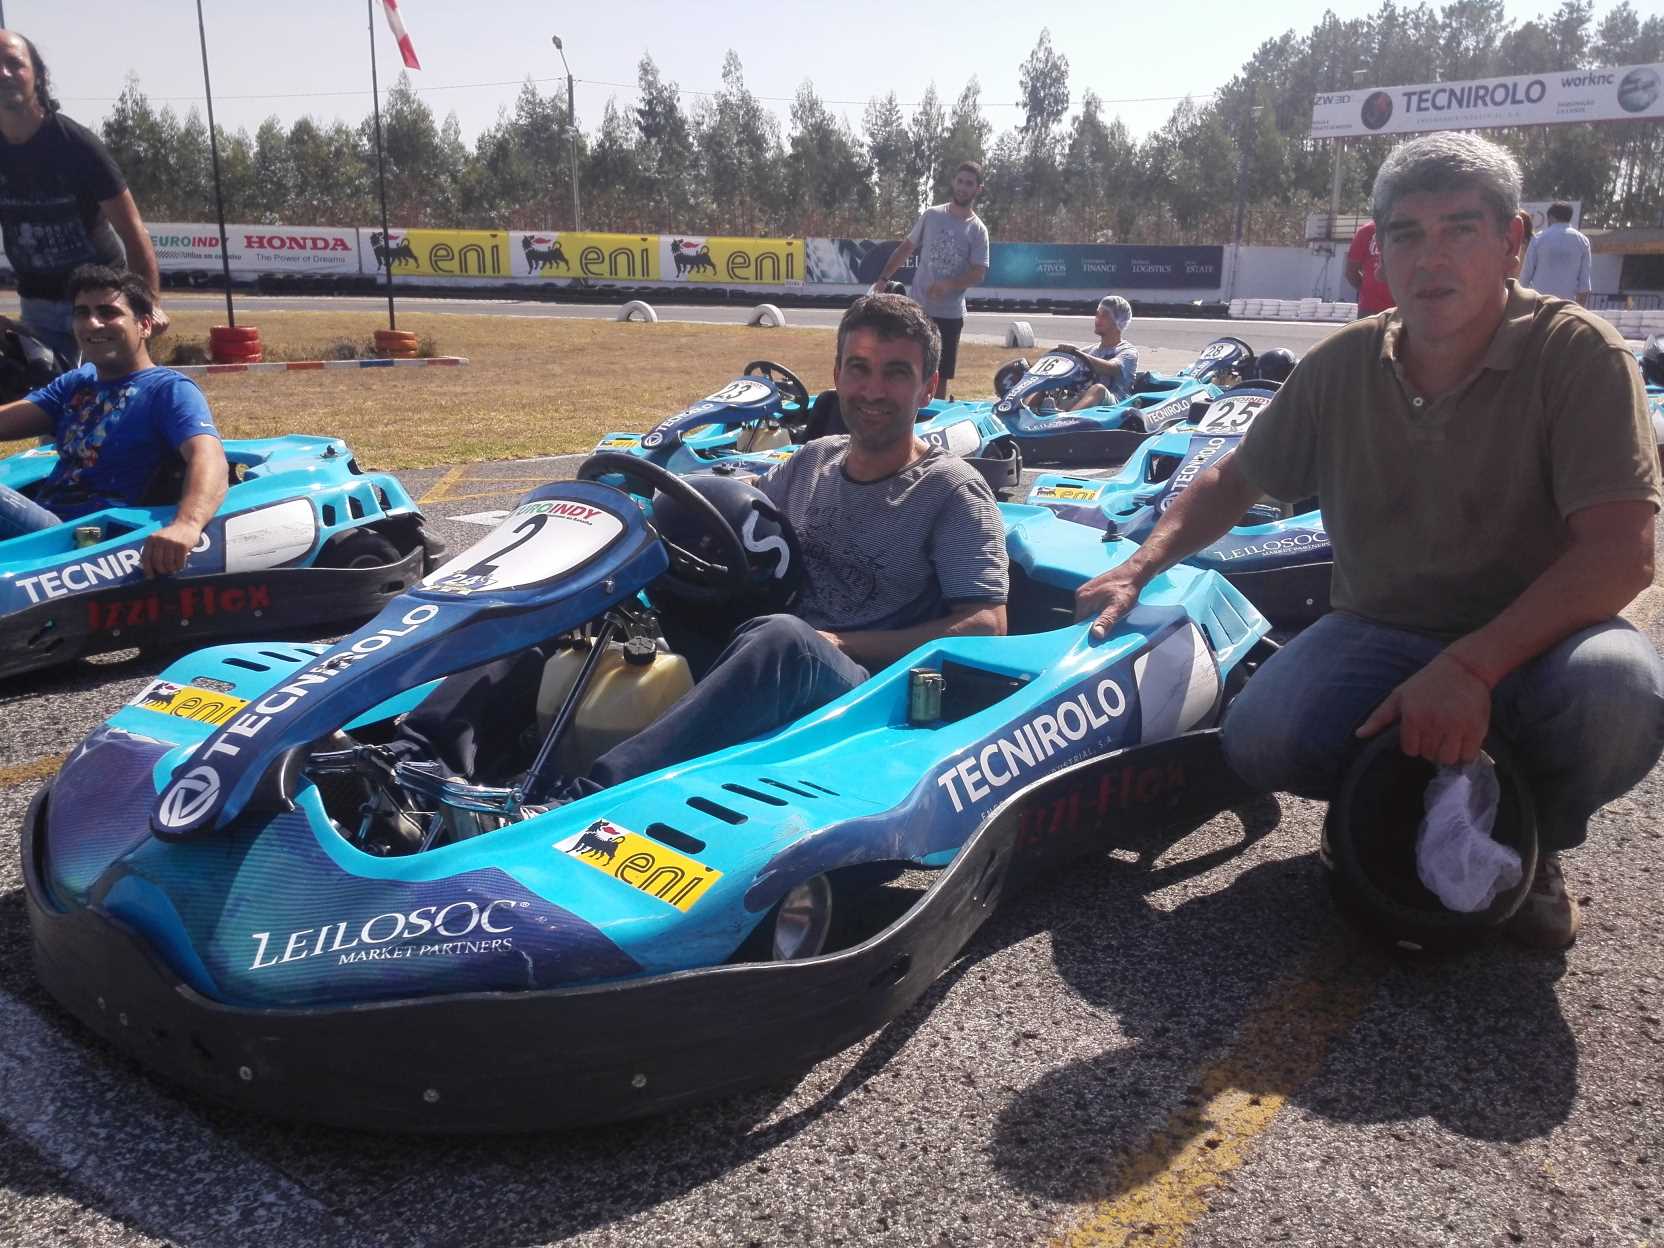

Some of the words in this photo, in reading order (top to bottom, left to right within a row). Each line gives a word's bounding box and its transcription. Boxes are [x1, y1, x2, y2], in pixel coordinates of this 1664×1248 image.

[1402, 79, 1546, 113] TECNIROLO
[151, 235, 229, 248] EUROIND
[244, 235, 352, 251] HONDA
[429, 233, 500, 274] eni
[257, 253, 272, 262] The
[274, 255, 300, 263] Power
[312, 256, 346, 264] Dreams
[580, 237, 649, 278] eni
[726, 241, 795, 281] eni
[1204, 344, 1224, 358] 28
[1034, 358, 1060, 373] 16
[716, 383, 752, 400] 23
[1146, 399, 1190, 424] TECNIROLO
[1206, 401, 1260, 428] 25
[460, 513, 550, 578] 2
[1214, 531, 1329, 561] LEILOSOC
[16, 532, 212, 604] TECNIRO
[170, 697, 245, 724] eni
[937, 679, 1126, 813] TECNIROLO
[614, 852, 714, 906] eni
[338, 946, 412, 965] MARKET
[419, 938, 513, 956] PARTNERS
